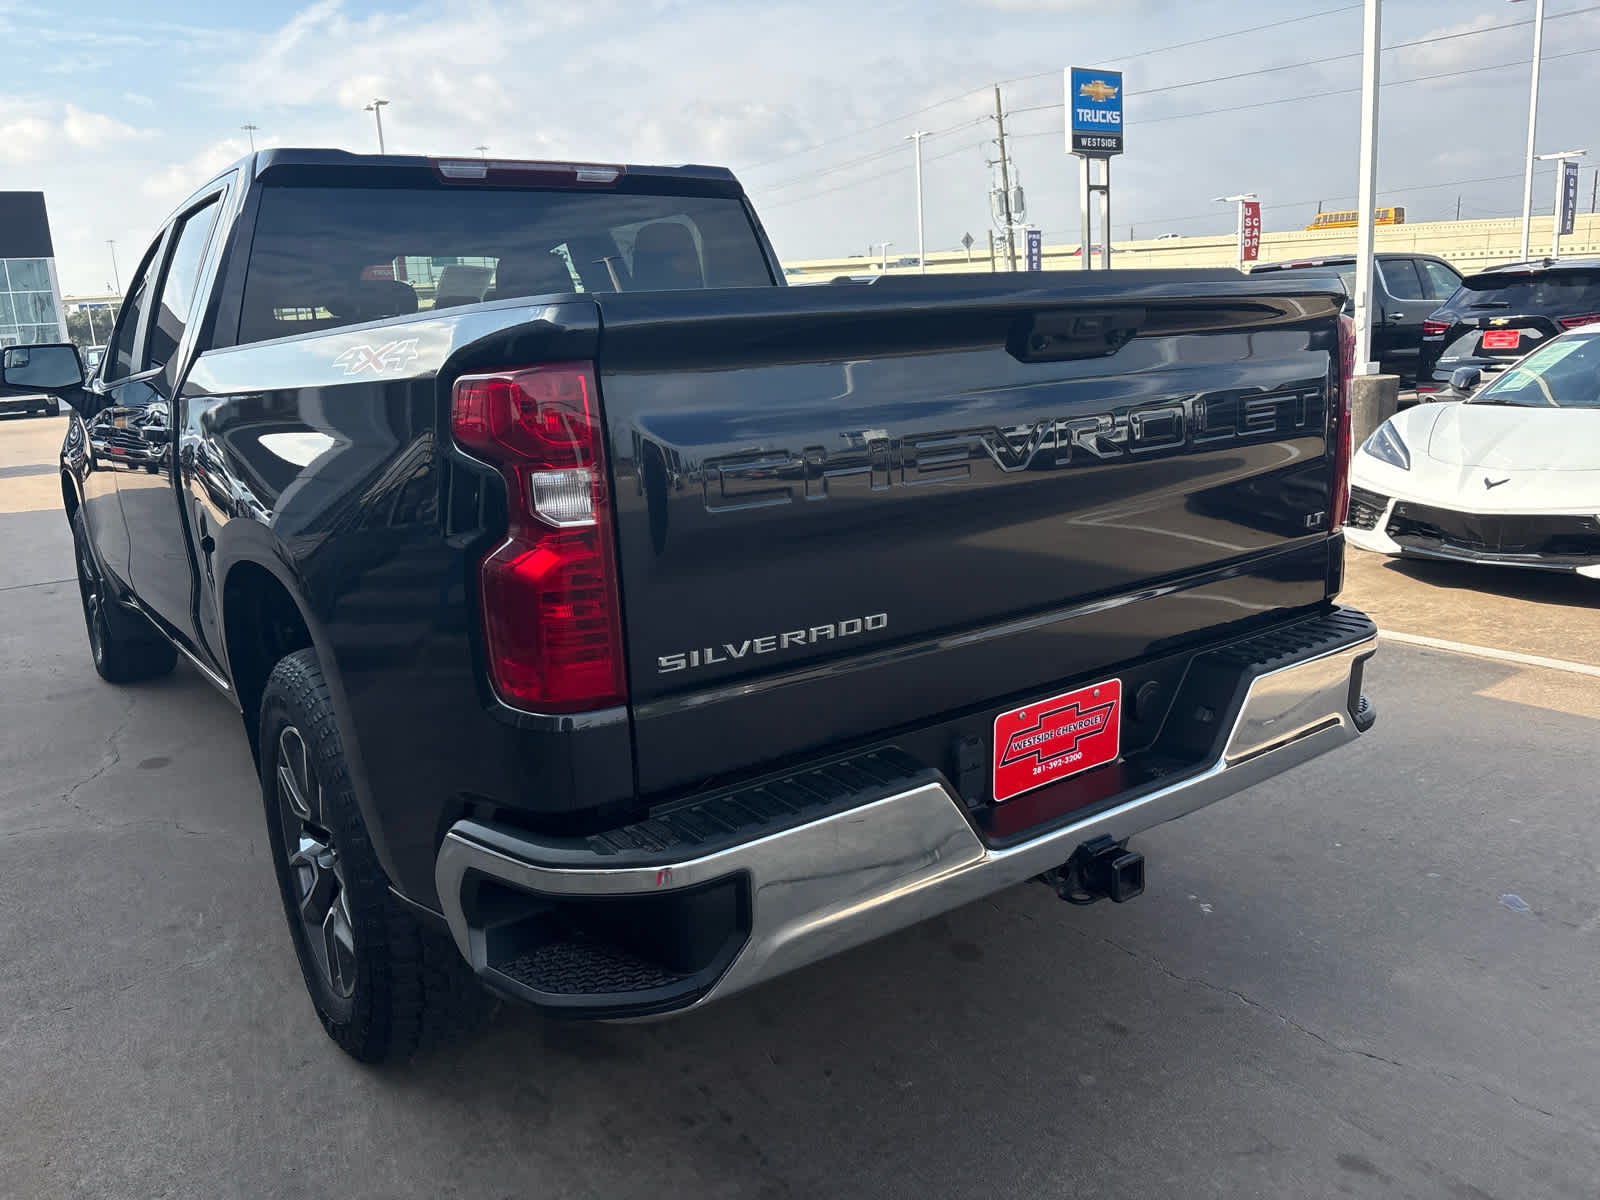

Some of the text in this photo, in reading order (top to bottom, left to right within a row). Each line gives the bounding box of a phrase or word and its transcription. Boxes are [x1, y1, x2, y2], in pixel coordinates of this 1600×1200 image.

[1076, 108, 1121, 124] TRUCKS
[1080, 137, 1118, 148] WESTSIDE
[1244, 208, 1252, 247] USED
[1251, 218, 1260, 256] CARS
[702, 385, 1321, 512] CHEVROLET
[1304, 511, 1325, 528] LT
[657, 612, 888, 674] SILVERADO
[1013, 715, 1103, 751] WESTSIDE CHEVROLET
[1032, 751, 1083, 776] 281-392-3200
